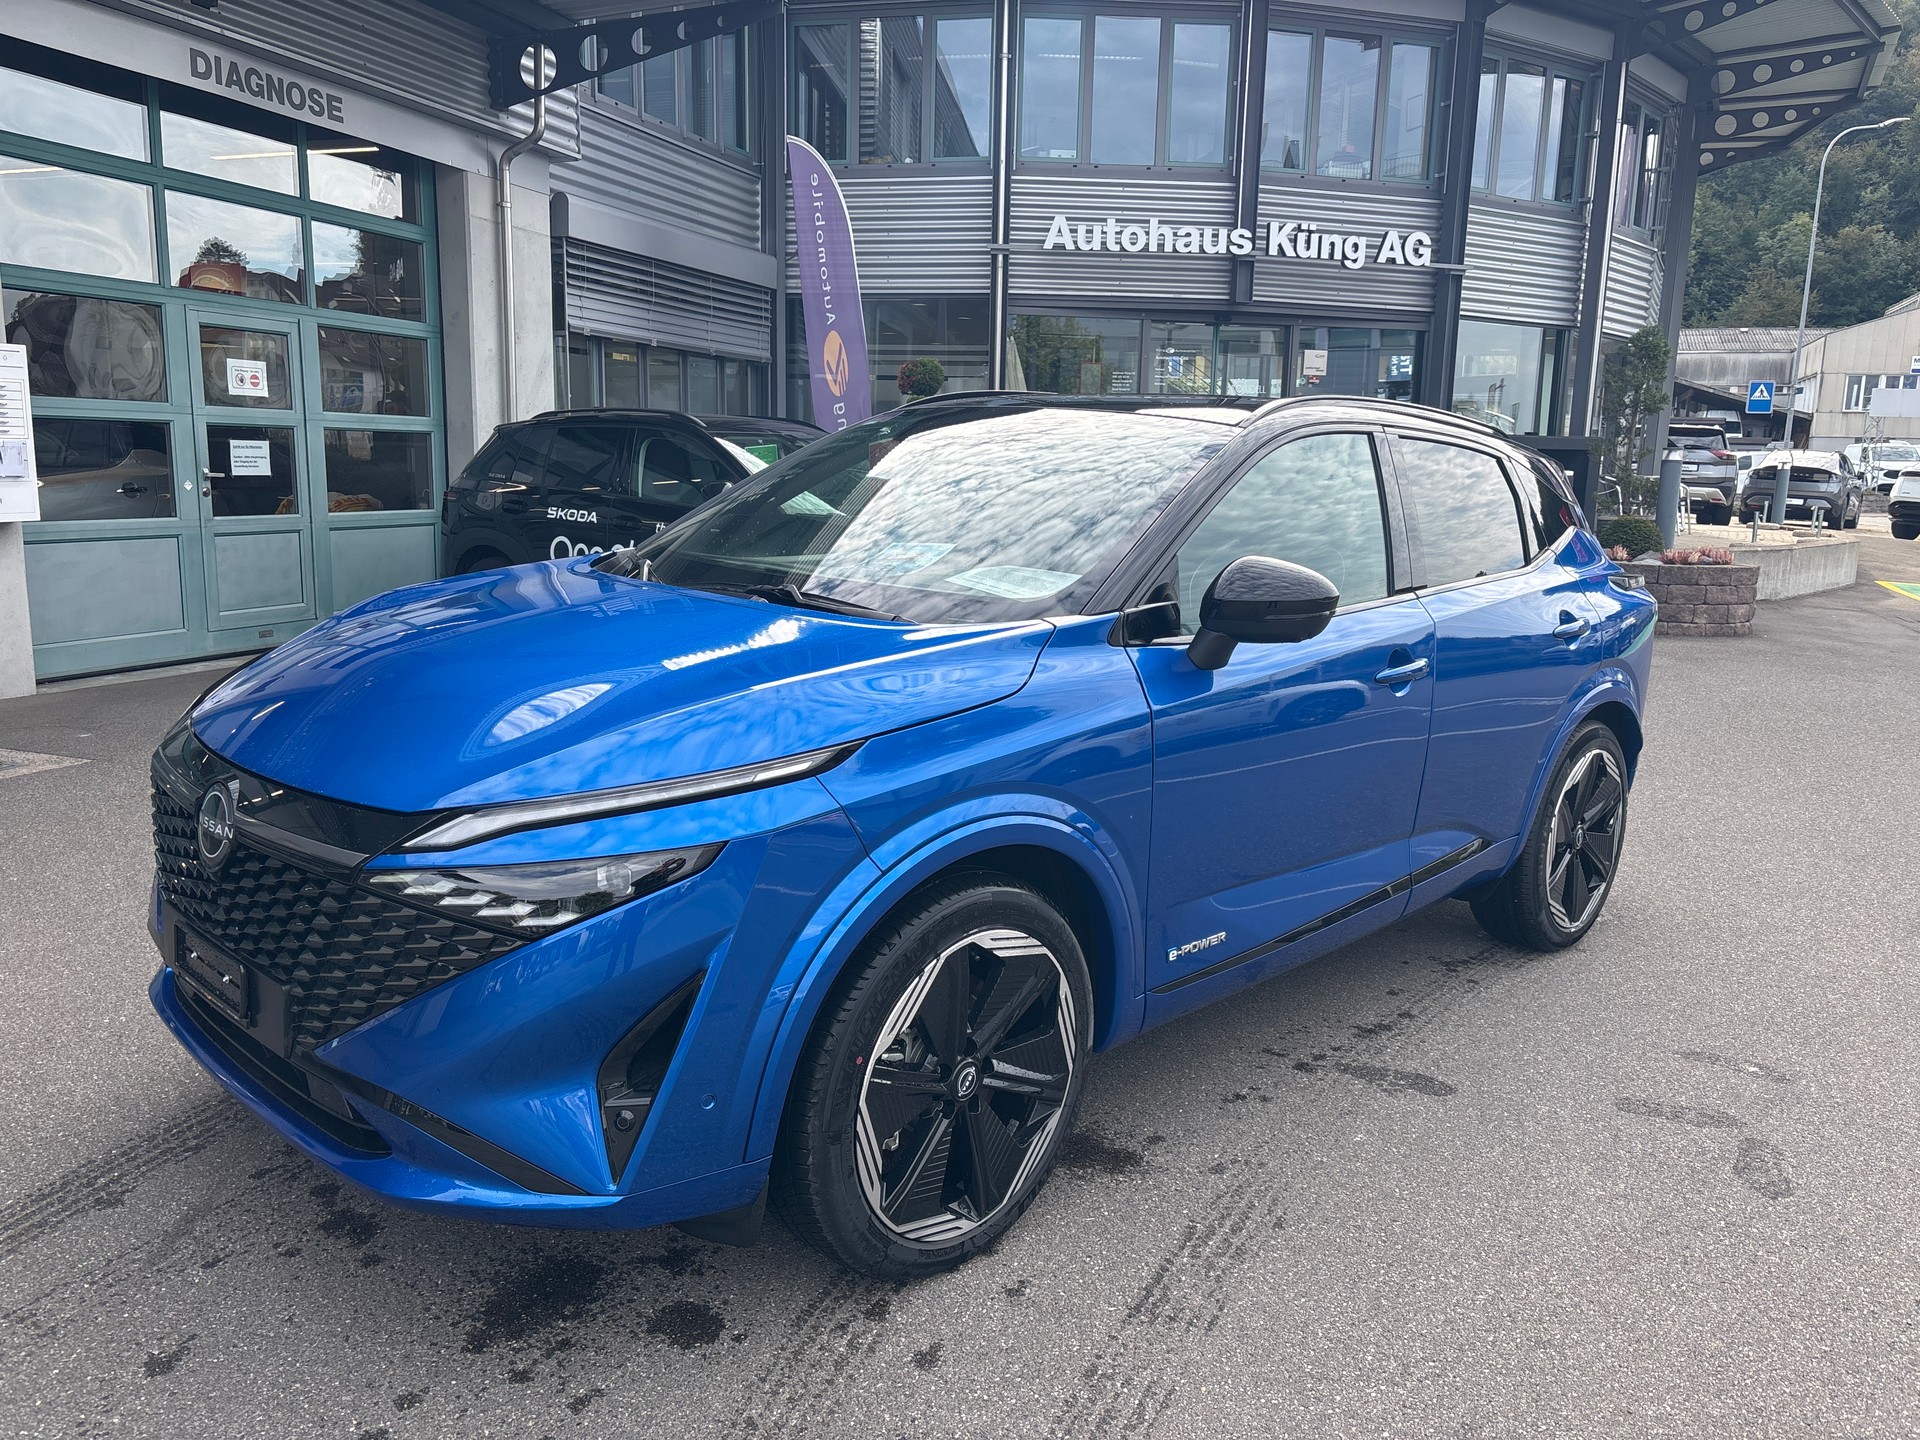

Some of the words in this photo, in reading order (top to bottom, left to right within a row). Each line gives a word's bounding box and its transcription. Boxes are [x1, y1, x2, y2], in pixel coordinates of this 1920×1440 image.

[189, 47, 344, 124] DIAGNOSE
[1043, 215, 1253, 255] Autohaus
[1267, 221, 1366, 269] Küng
[1374, 230, 1432, 266] AG
